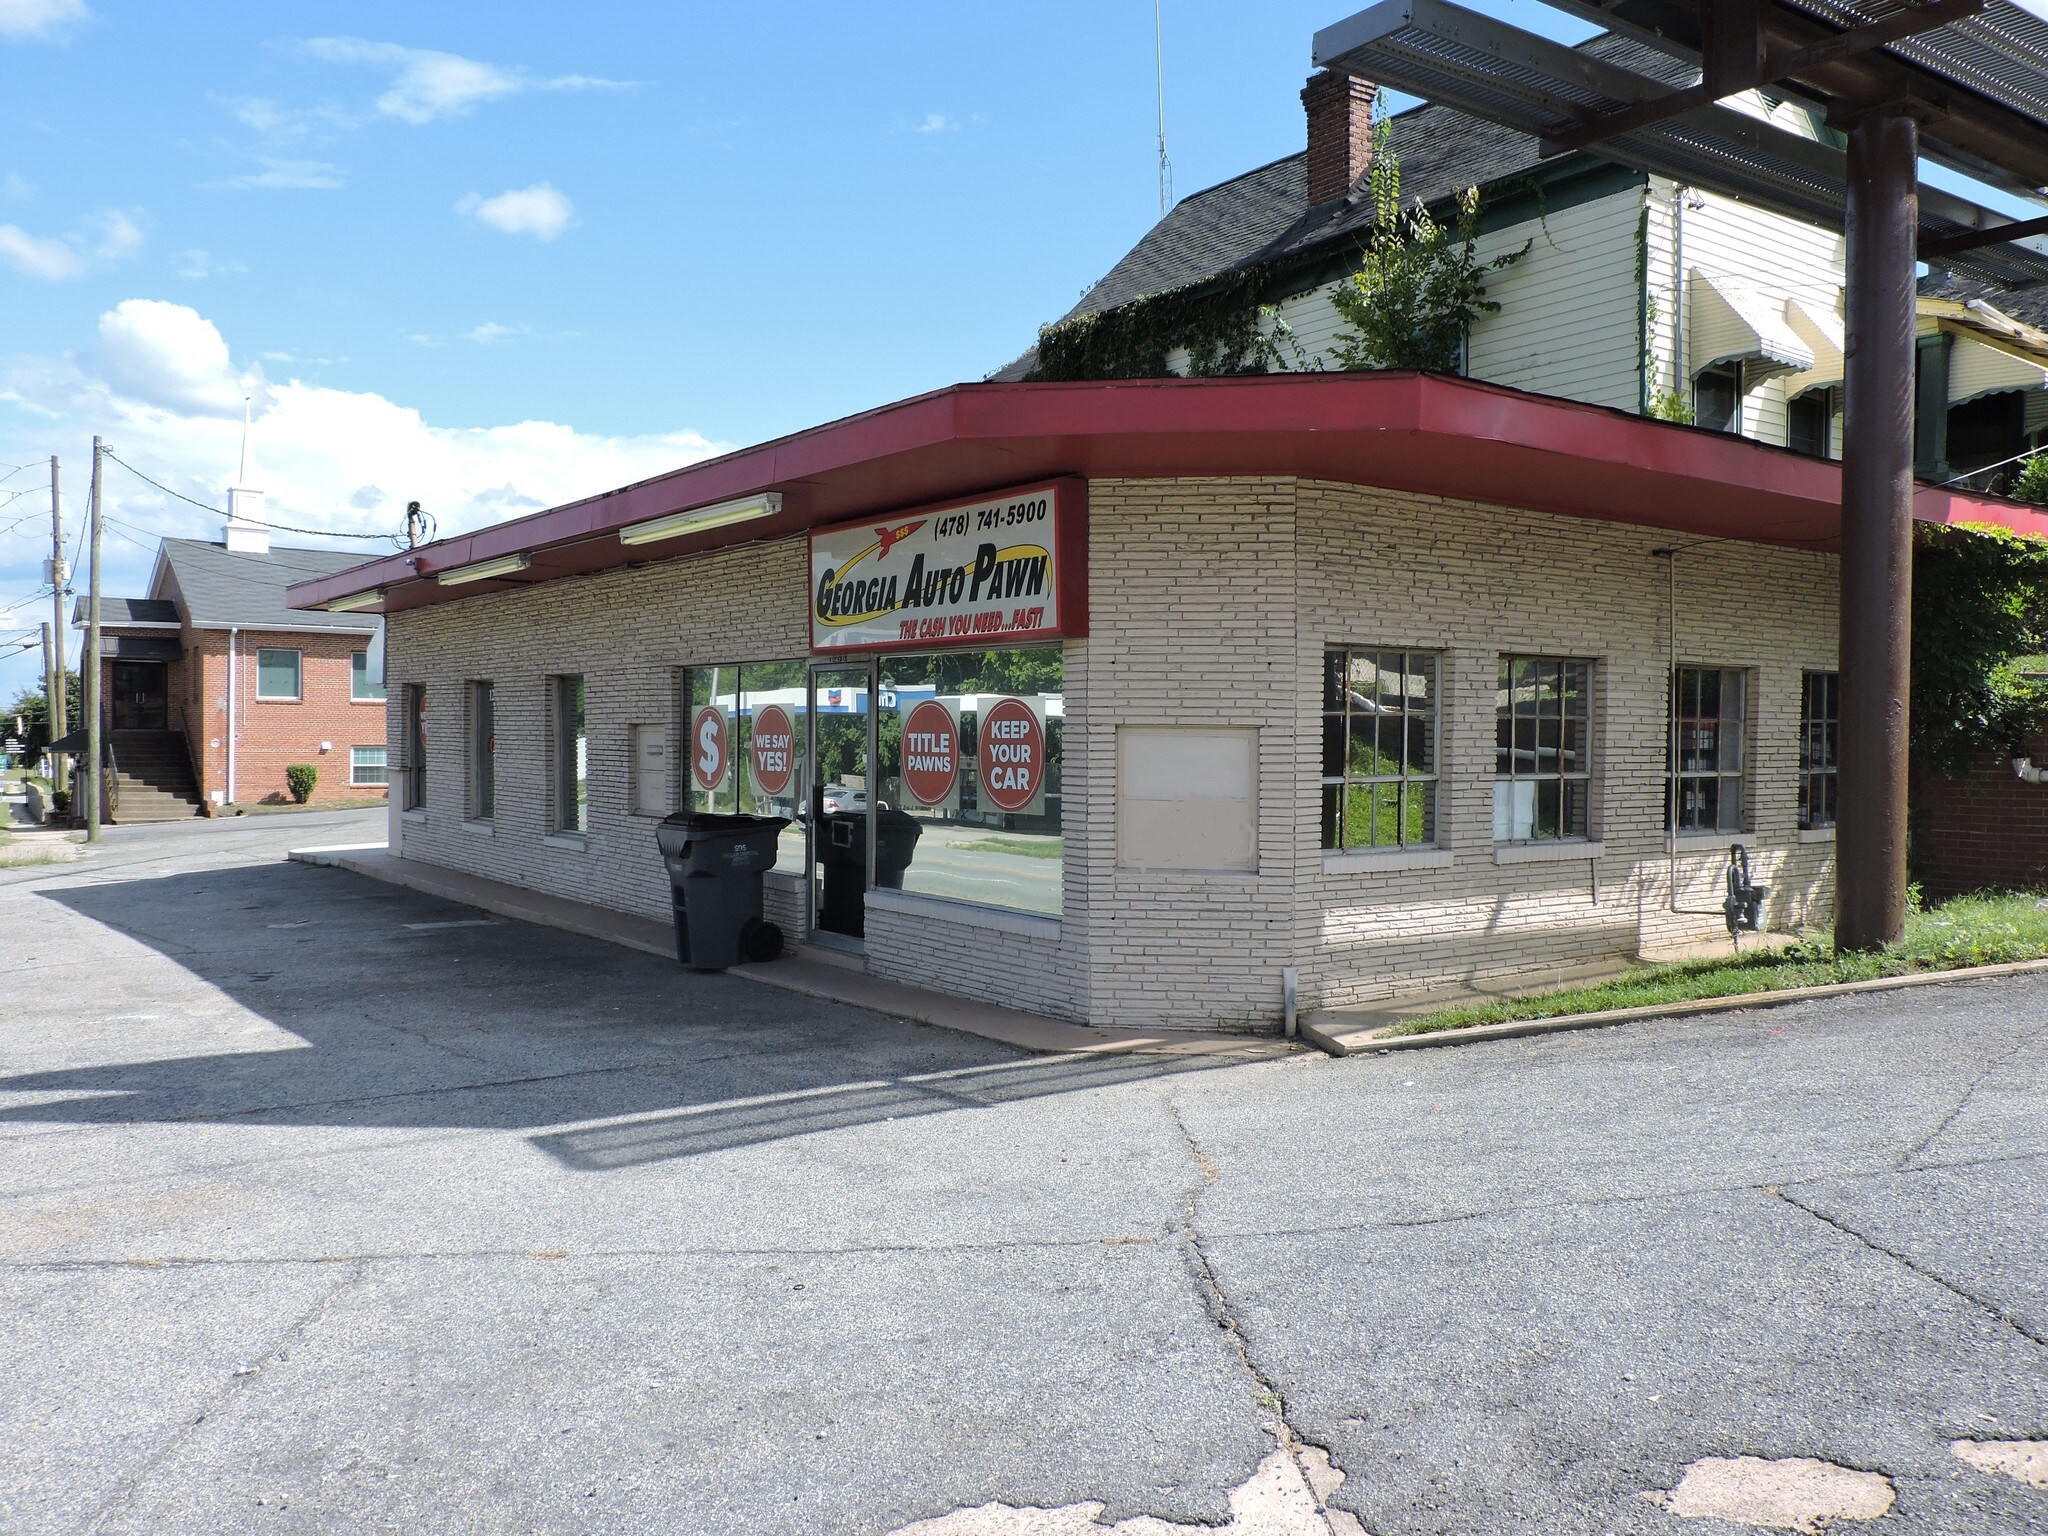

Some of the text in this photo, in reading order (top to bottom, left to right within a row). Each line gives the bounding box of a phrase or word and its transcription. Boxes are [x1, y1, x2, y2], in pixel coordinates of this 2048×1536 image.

[934, 499, 1047, 541] (478) 741-5900
[816, 543, 1048, 618] GEORGIA AUTO PAWN
[900, 620, 918, 639] THE
[919, 616, 947, 638] CASH
[949, 614, 972, 635] YOU
[991, 720, 1030, 739] KEEP
[756, 734, 790, 749] WE SAY
[908, 733, 949, 753] TITLE
[757, 751, 787, 772] YES!
[989, 744, 1031, 763] YOUR
[908, 755, 951, 773] PAWNS
[990, 766, 1030, 791] CAR
